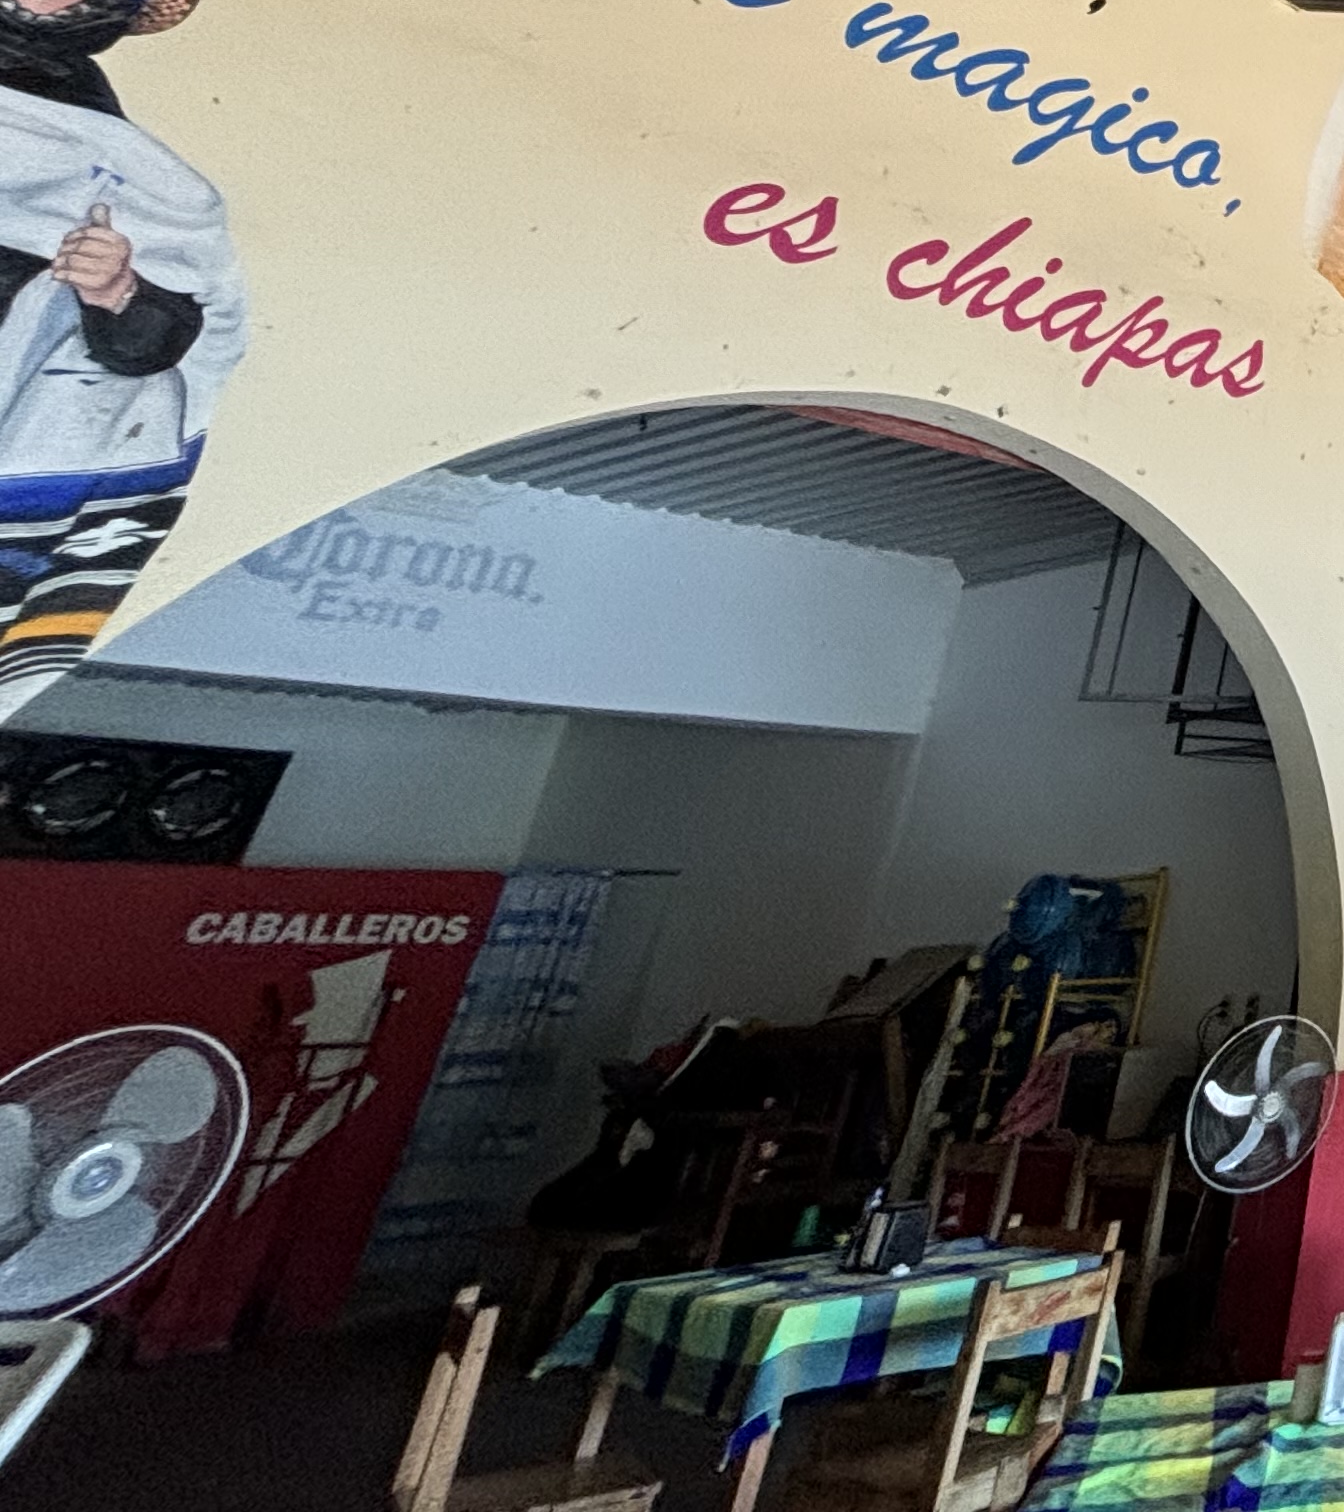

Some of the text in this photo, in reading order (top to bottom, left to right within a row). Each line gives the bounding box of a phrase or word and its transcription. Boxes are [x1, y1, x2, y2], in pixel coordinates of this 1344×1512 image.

[845, 1, 1242, 217] magico,
[703, 182, 1265, 398] es chiapas
[185, 911, 471, 946] CABALLEROS
